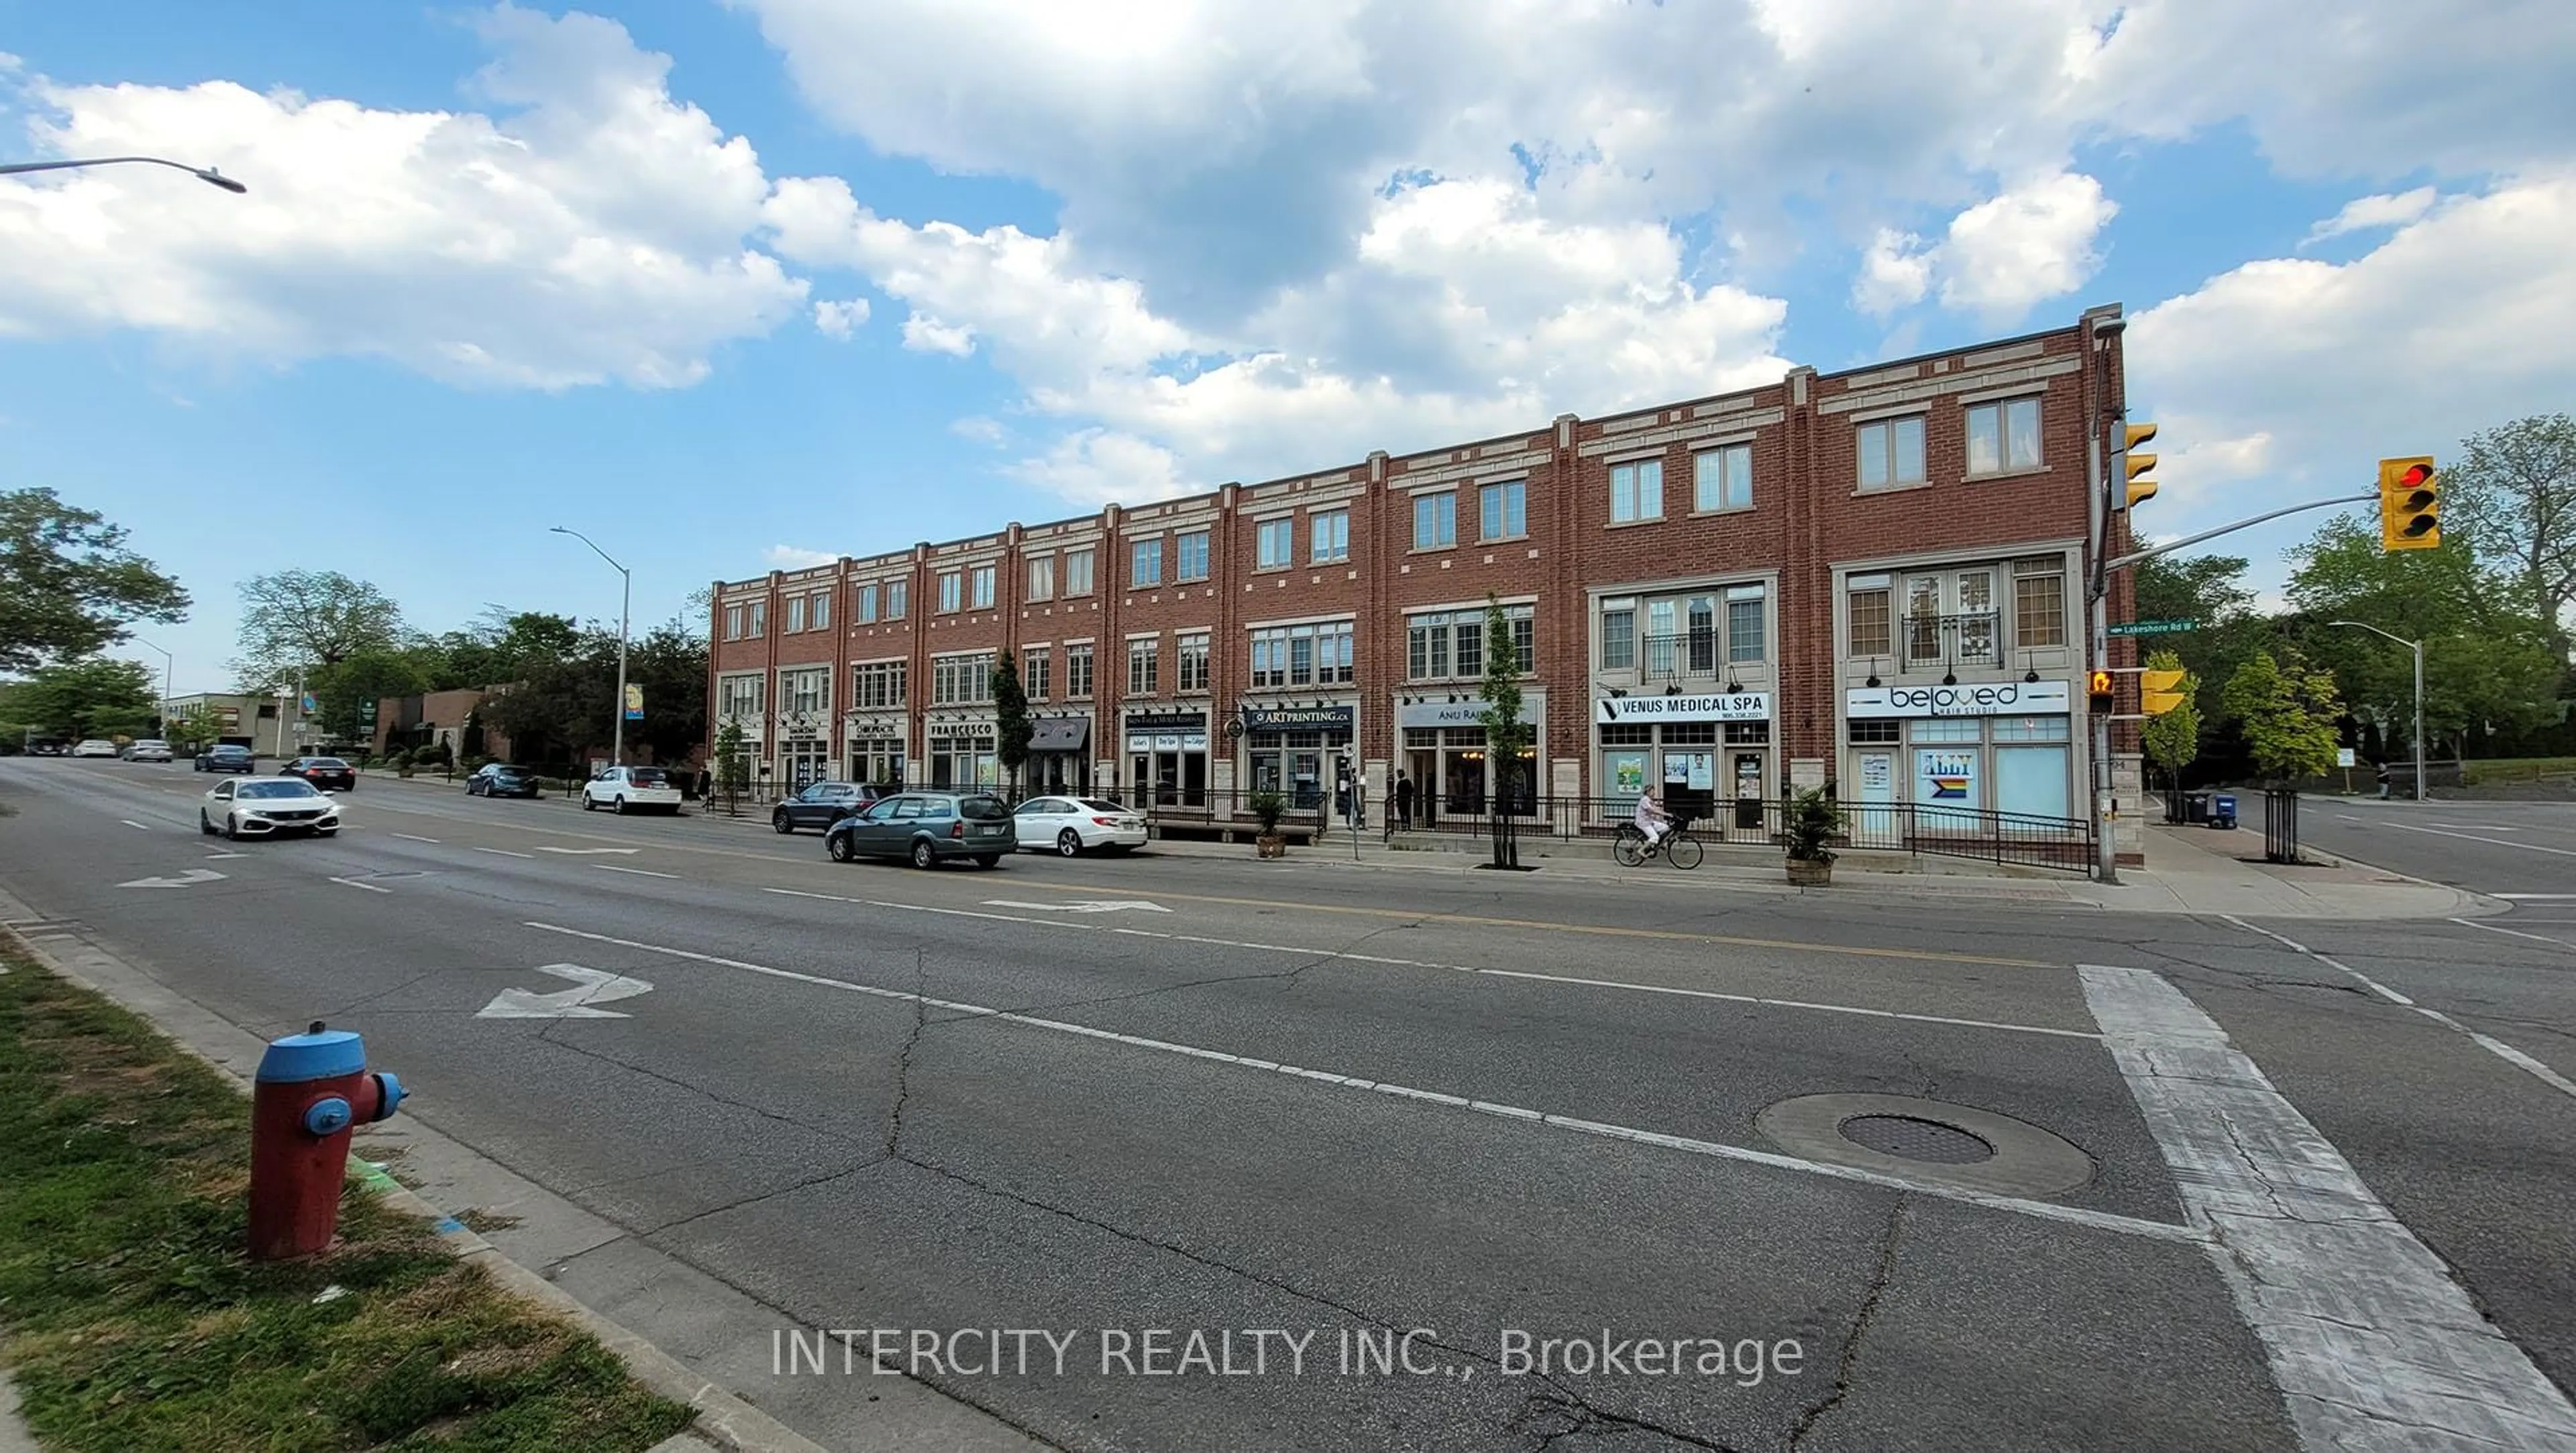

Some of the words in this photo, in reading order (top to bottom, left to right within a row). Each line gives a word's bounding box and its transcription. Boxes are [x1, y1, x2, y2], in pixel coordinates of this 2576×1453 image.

[2123, 625, 2168, 633] Lakeshore
[2170, 622, 2182, 631] Rd
[2183, 622, 2192, 631] W
[1623, 700, 1662, 713] VENUS
[1667, 698, 1728, 712] MEDICAL
[1733, 696, 1762, 711] SPA
[1890, 683, 2018, 716] beloved
[1438, 710, 1461, 720] ANU
[1964, 706, 1997, 714] STUDIO
[931, 724, 991, 735] FRANCESCO
